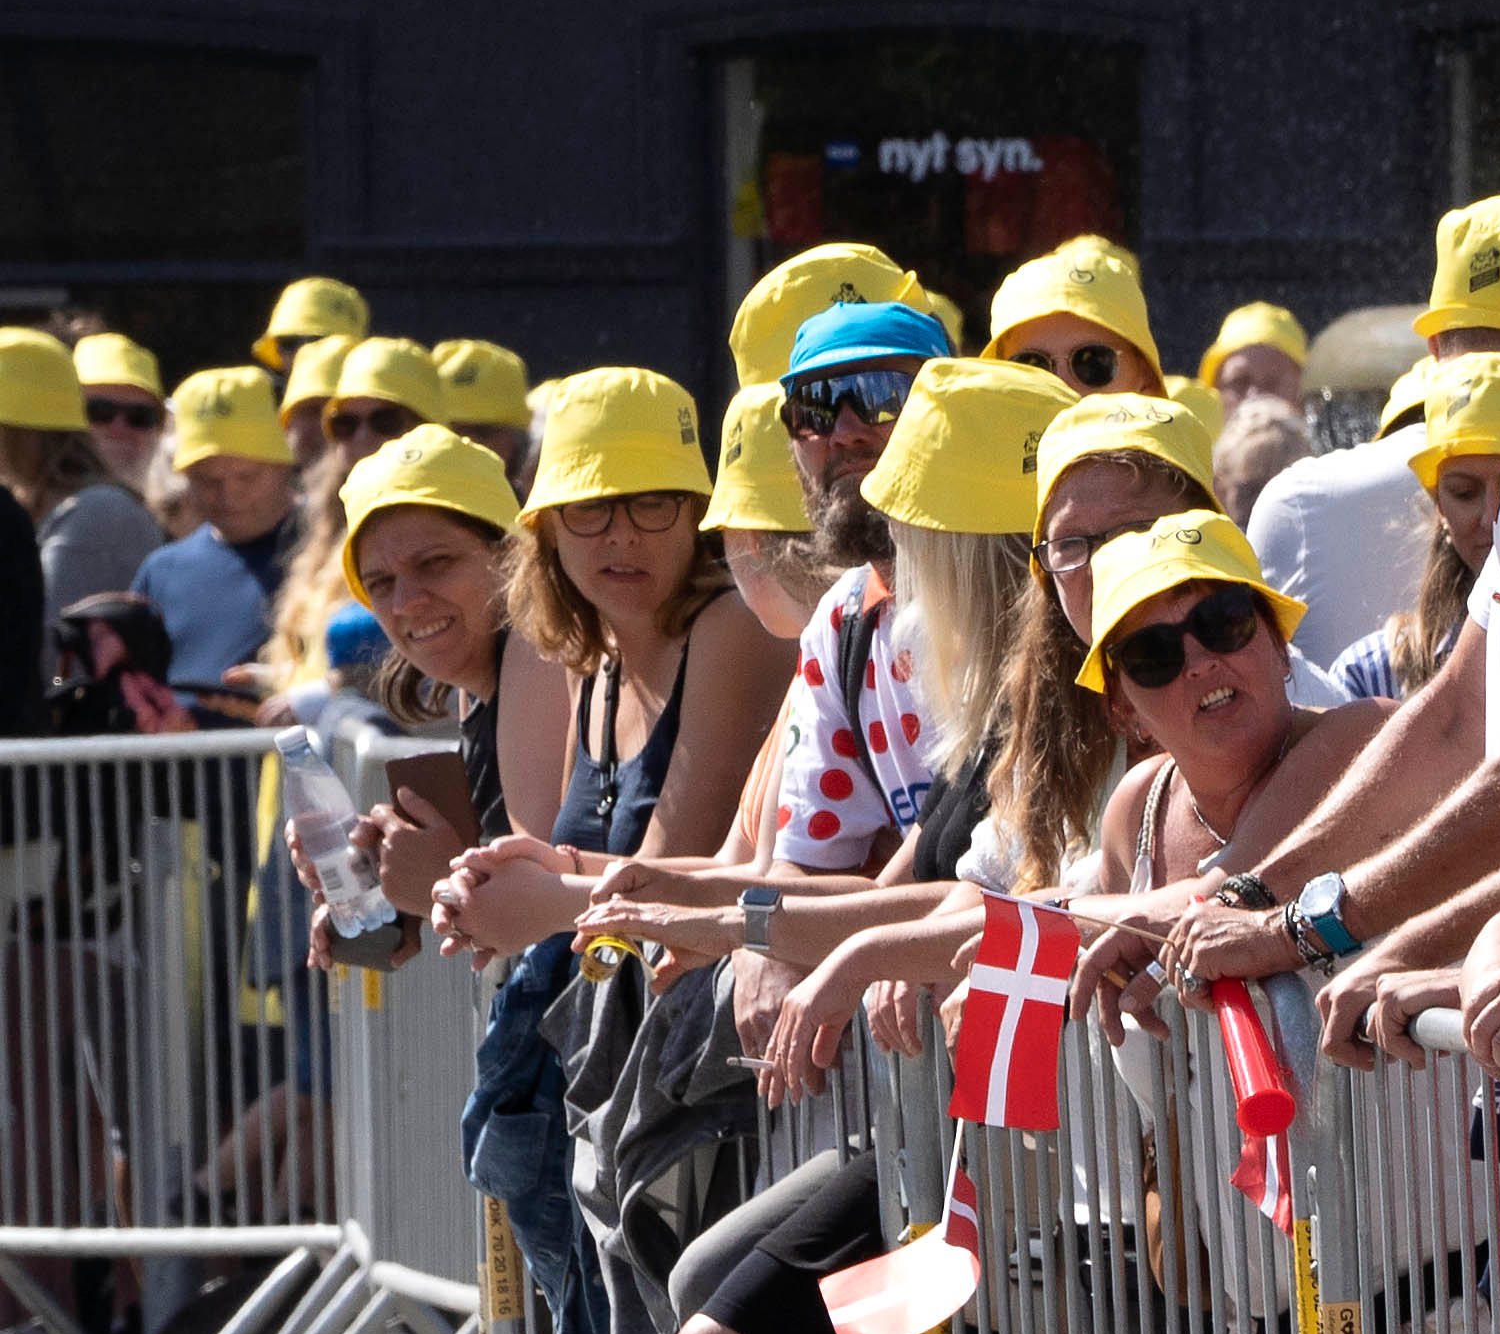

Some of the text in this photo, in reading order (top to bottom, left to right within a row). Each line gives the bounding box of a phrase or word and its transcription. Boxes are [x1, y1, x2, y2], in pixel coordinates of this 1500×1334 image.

[878, 130, 1045, 182] nyt syn.
[491, 1234, 504, 1252] 70
[493, 1256, 507, 1273] 20
